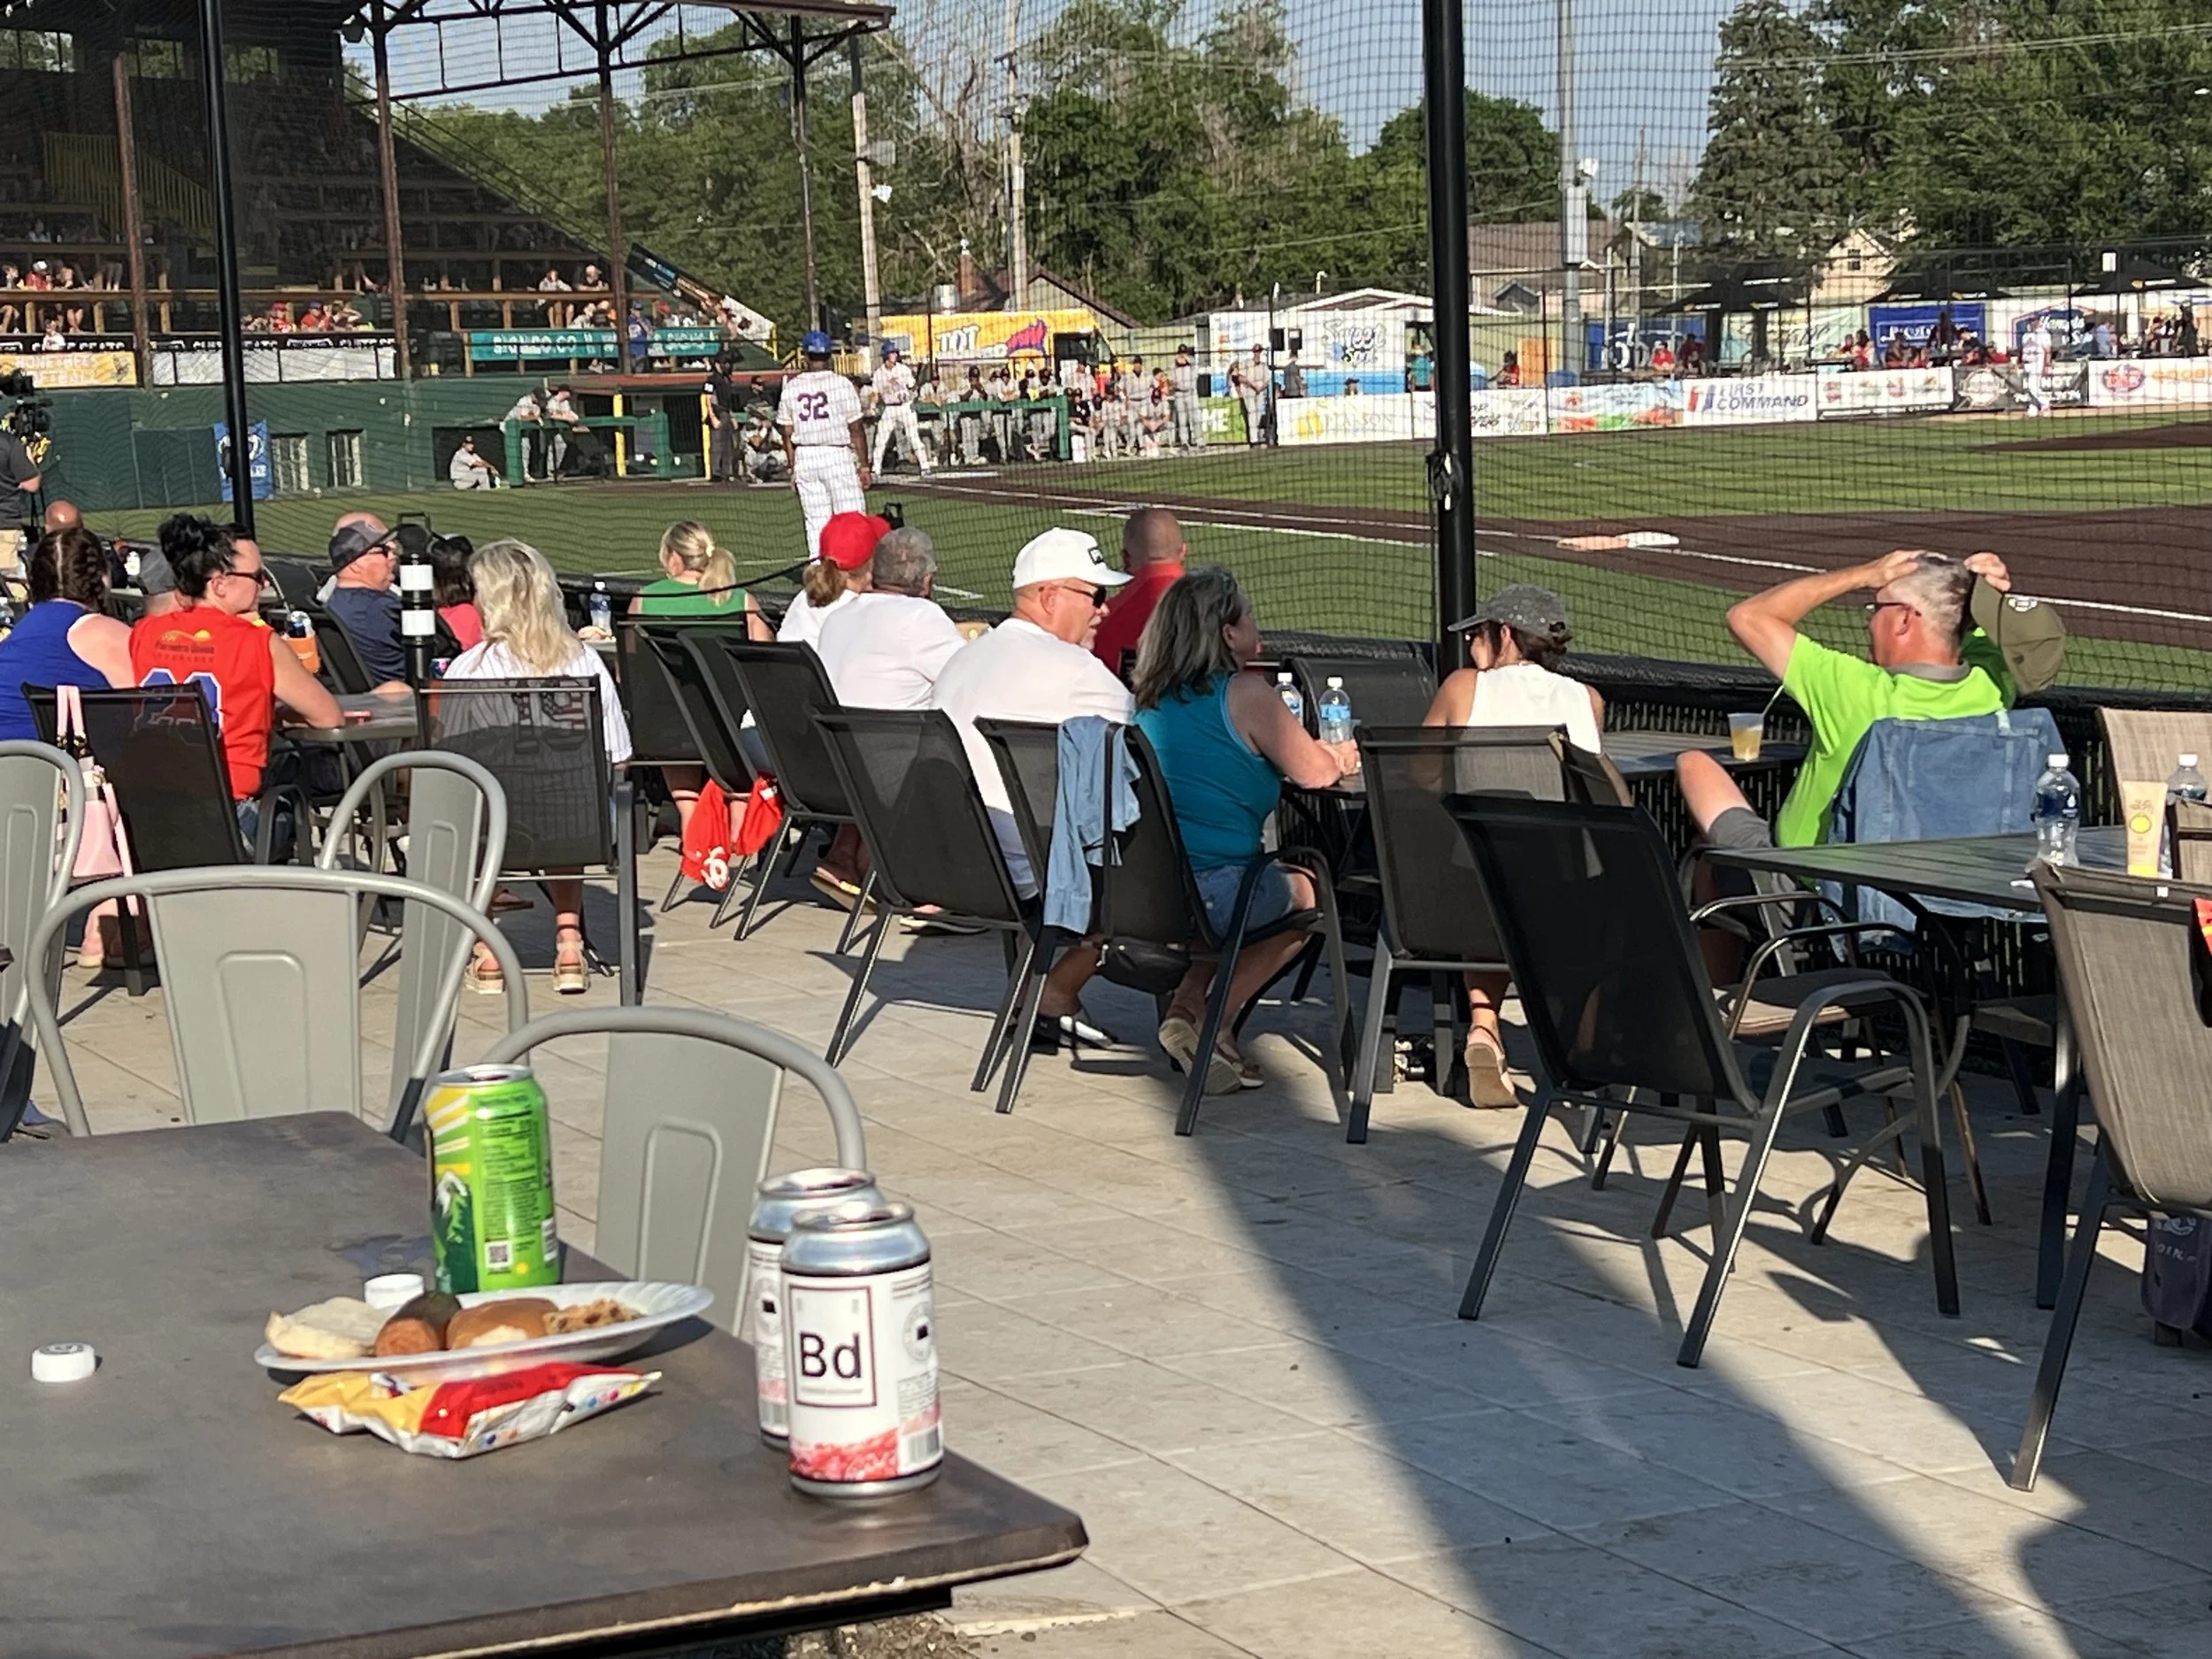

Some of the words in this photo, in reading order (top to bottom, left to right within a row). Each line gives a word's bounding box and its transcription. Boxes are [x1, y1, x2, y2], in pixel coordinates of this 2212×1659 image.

[797, 391, 829, 421] 32
[1717, 395, 1809, 411] COMMAND
[800, 1331, 862, 1379] Bd
